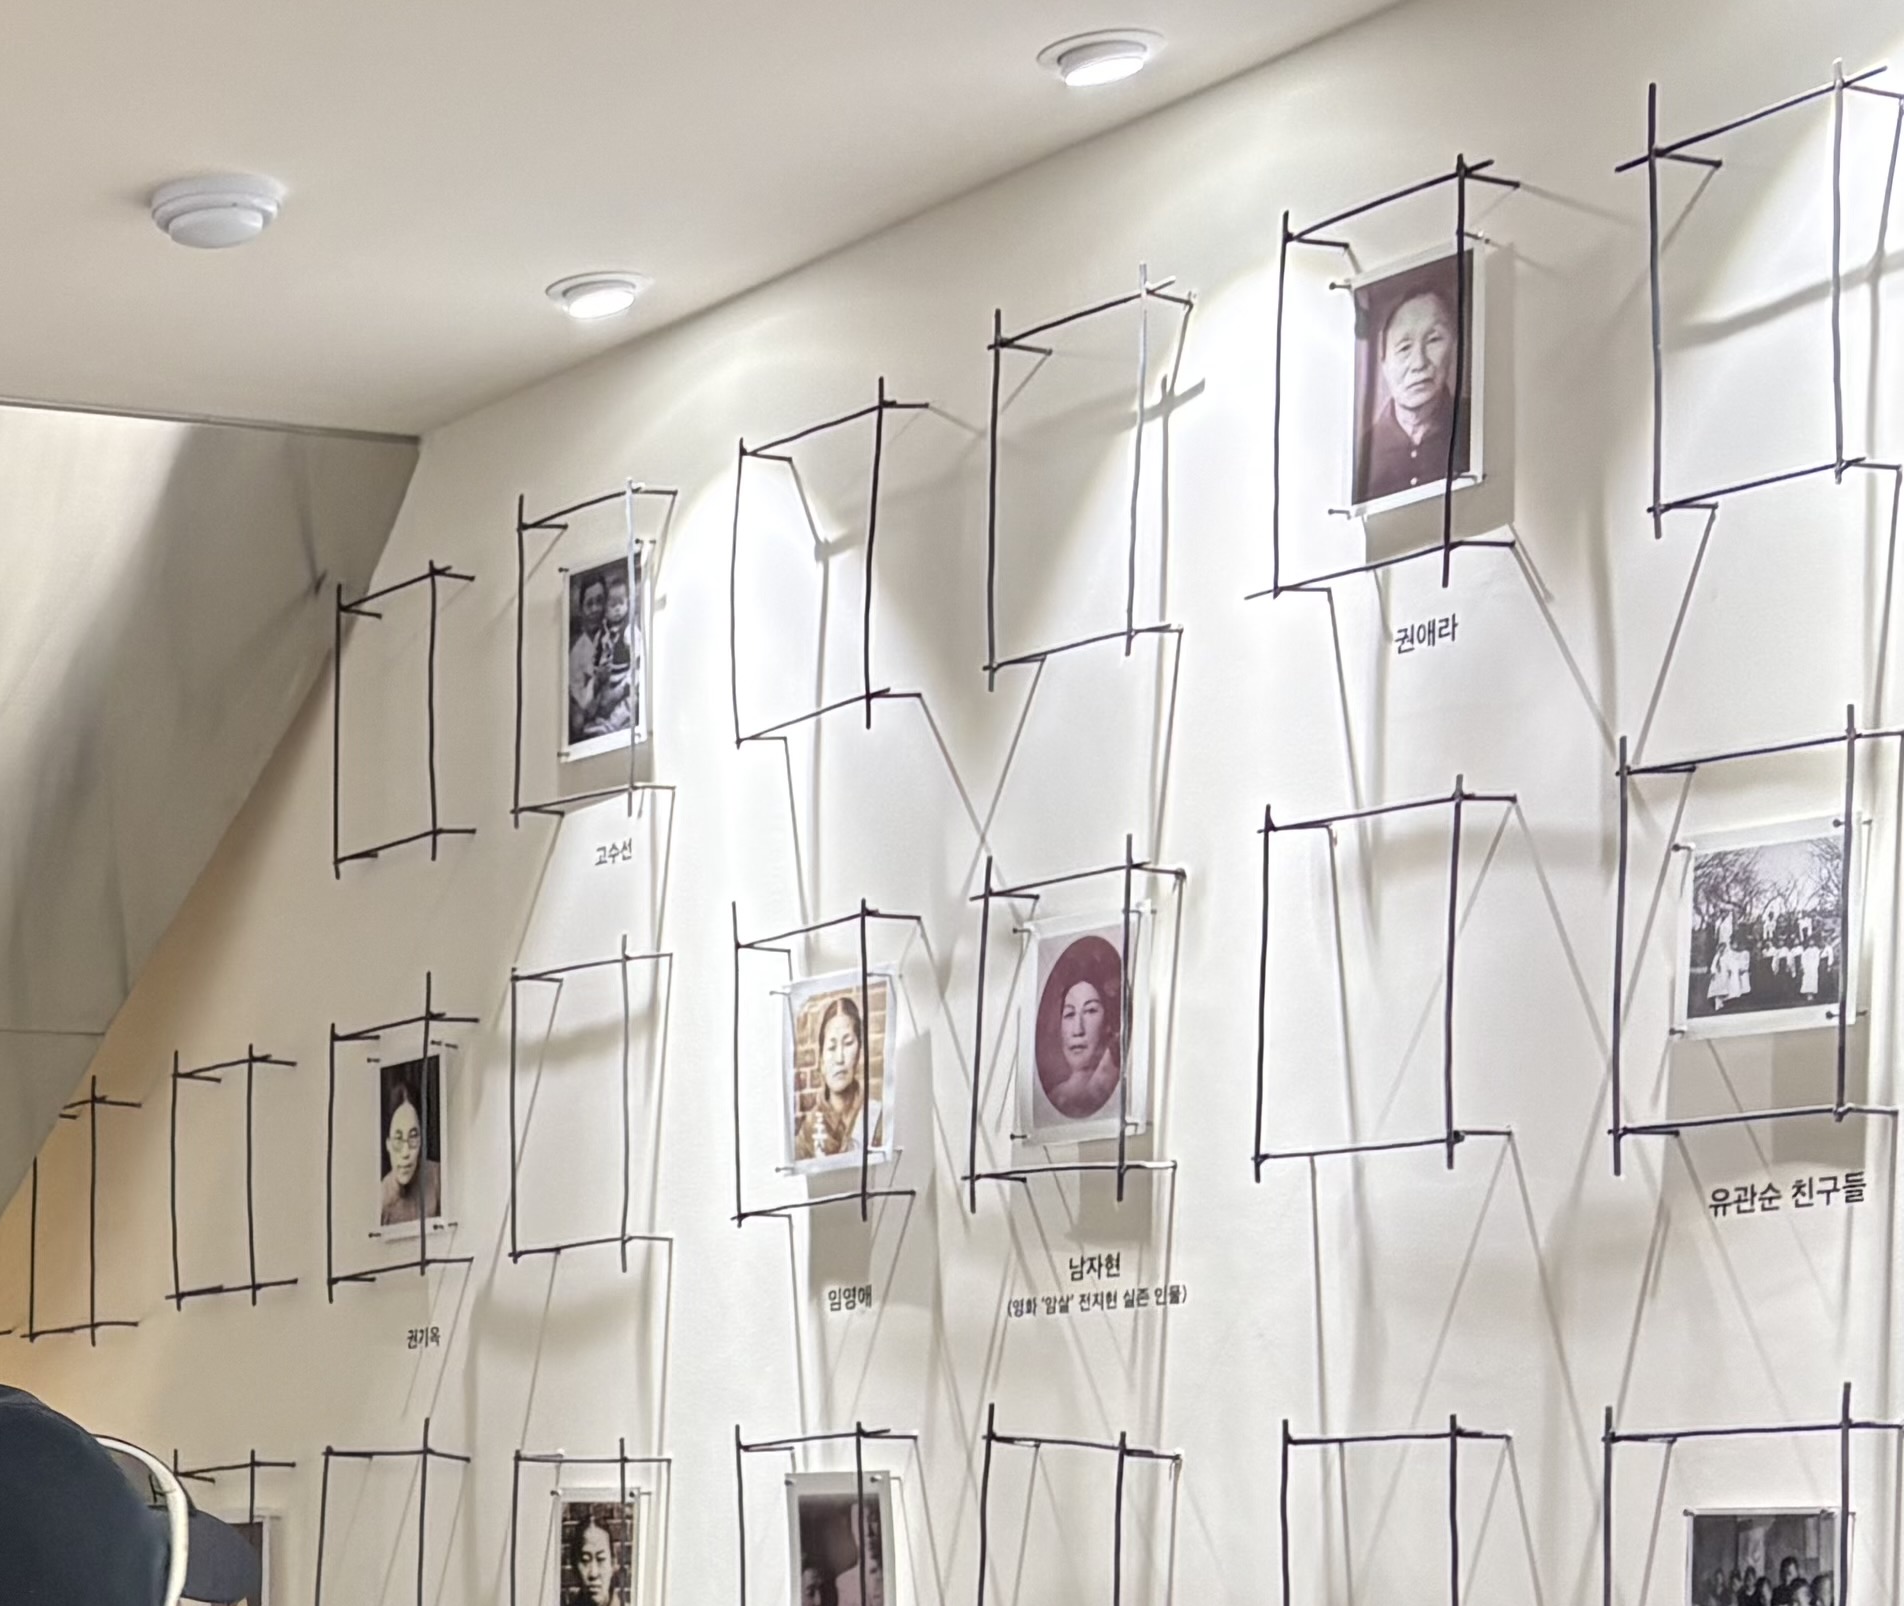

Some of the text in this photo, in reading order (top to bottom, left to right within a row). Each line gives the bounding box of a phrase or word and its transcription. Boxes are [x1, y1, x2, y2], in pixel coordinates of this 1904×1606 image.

[1394, 612, 1460, 655] 권애라
[594, 837, 633, 866] 고수선
[1708, 1171, 1867, 1217] 유관순 친구들
[1069, 1252, 1121, 1281] 남자현
[1079, 1290, 1118, 1312] 전지현
[1123, 1287, 1150, 1308] 실존
[1154, 1284, 1187, 1306] 인물)
